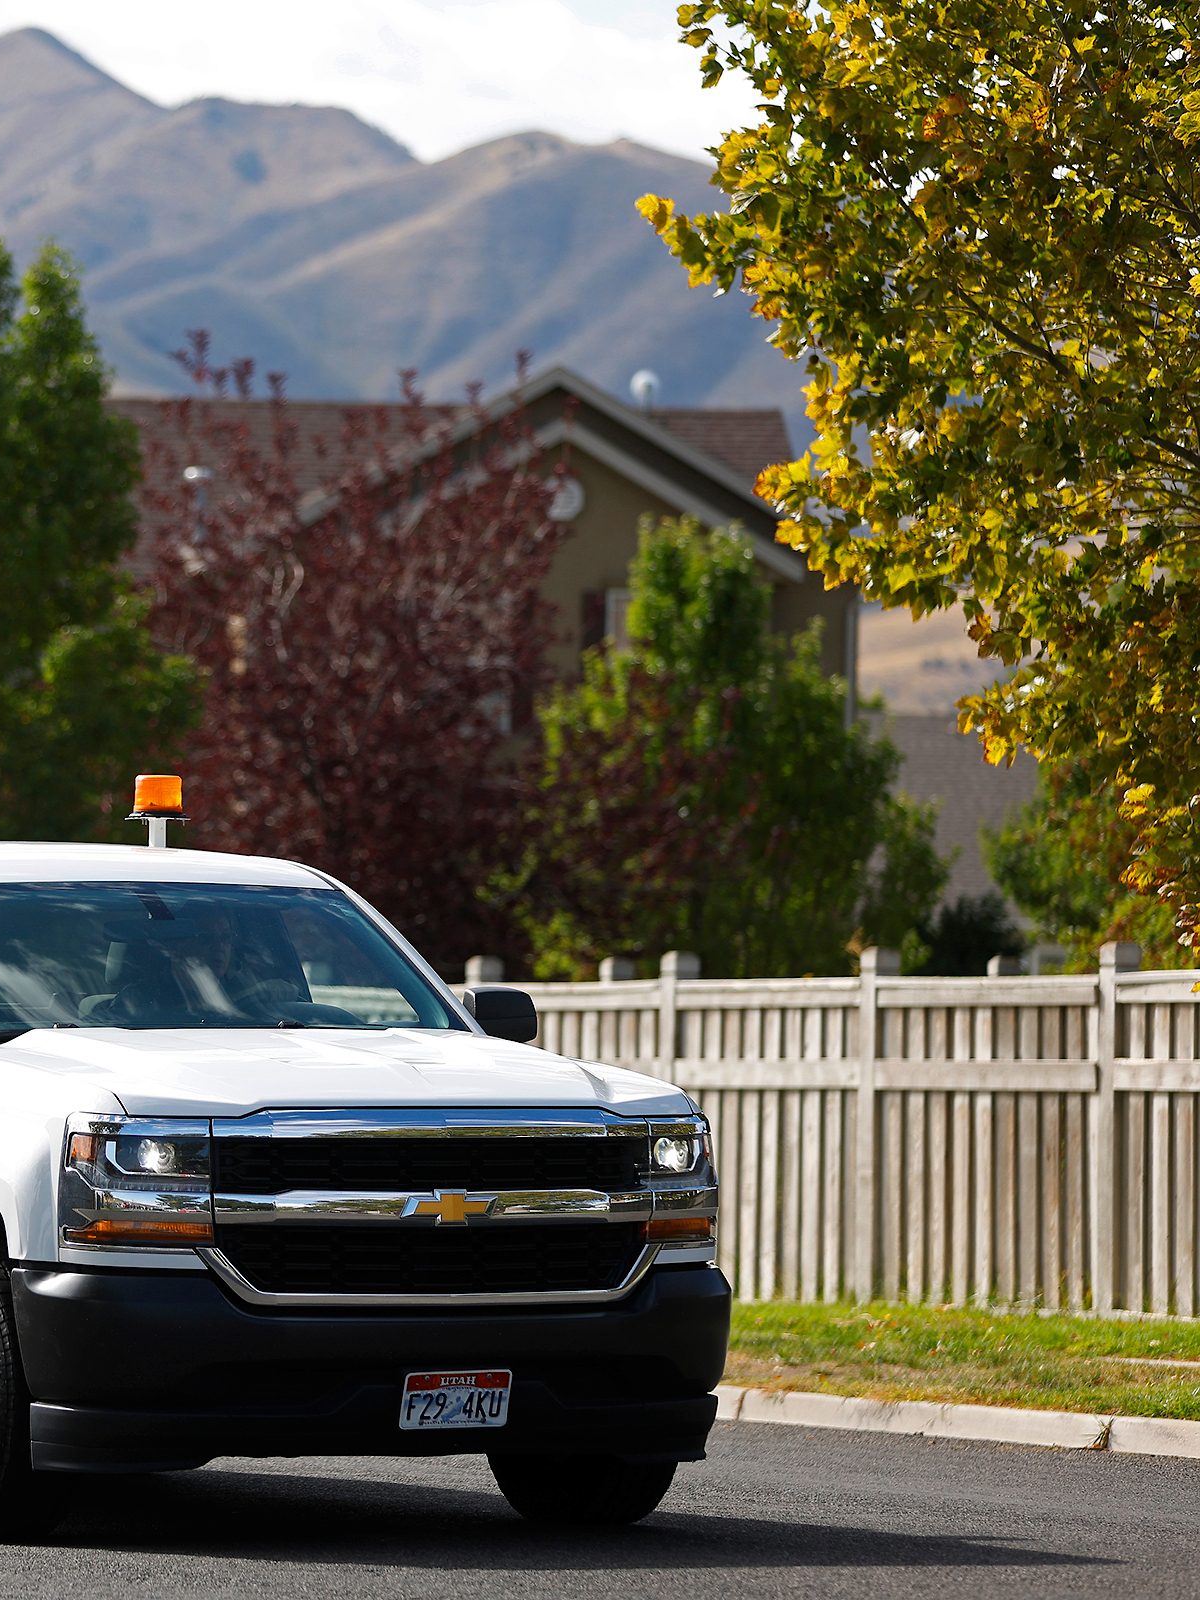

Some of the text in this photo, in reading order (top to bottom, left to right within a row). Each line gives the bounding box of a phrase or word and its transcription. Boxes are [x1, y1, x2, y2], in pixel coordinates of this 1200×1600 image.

[440, 1375, 477, 1386] UTAH
[406, 1390, 504, 1421] F29 4KU
